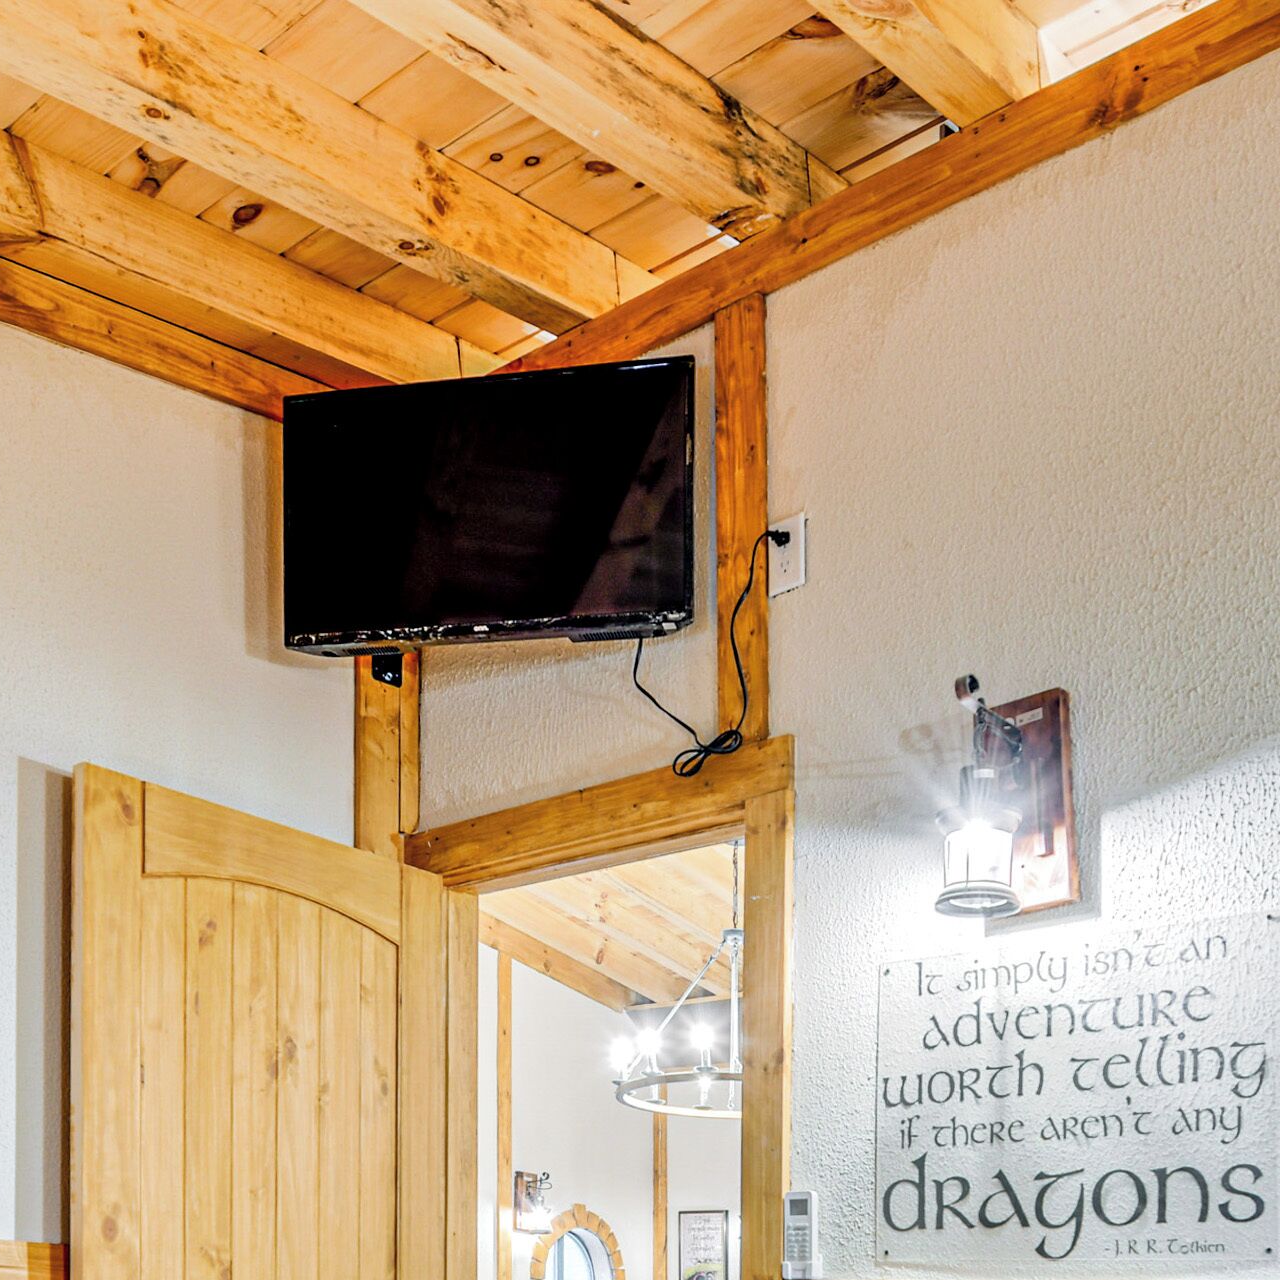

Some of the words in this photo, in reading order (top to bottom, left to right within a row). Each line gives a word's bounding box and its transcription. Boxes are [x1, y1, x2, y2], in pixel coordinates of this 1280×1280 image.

[915, 962, 944, 997] It
[956, 951, 1068, 995] simply
[1084, 929, 1167, 977] isn't
[1179, 934, 1228, 965] an
[922, 985, 1214, 1050] adventure
[882, 1050, 1046, 1109] worth
[1070, 1032, 1268, 1099] telling
[899, 1115, 921, 1150] if
[932, 1117, 1025, 1147] there
[1040, 1095, 1153, 1143] aren't
[1171, 1104, 1243, 1145] any
[882, 1151, 1266, 1260] dragons
